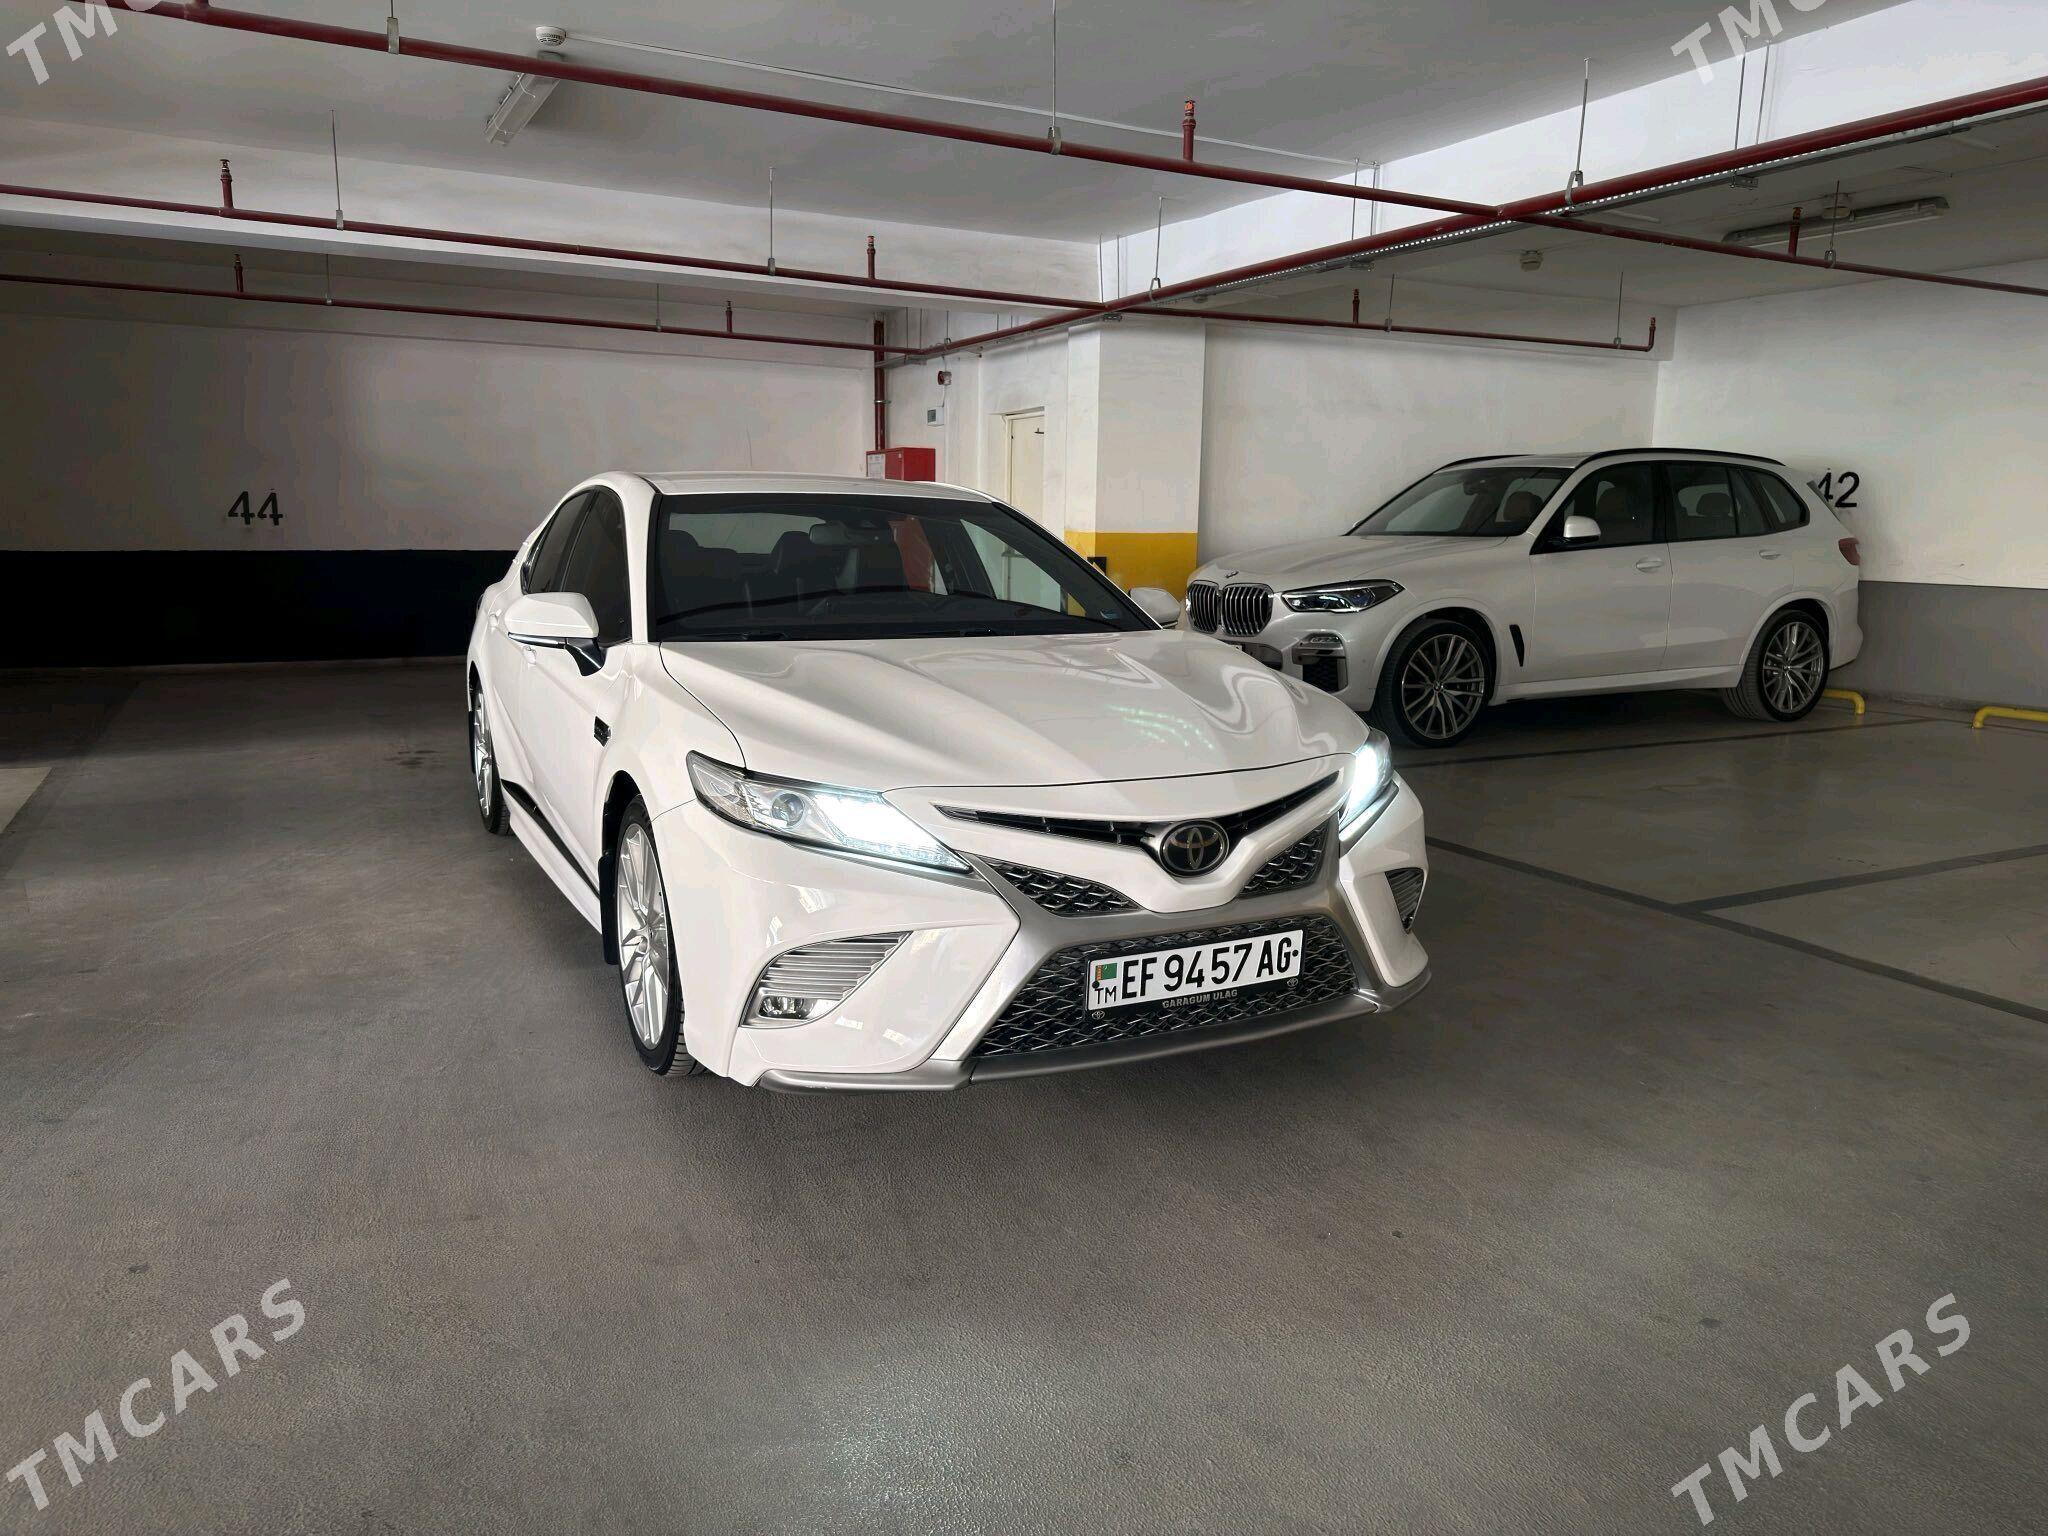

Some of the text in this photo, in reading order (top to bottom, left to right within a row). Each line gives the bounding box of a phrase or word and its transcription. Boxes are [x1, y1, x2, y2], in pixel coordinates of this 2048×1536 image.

[227, 491, 284, 526] 44
[1121, 936, 1292, 999] EF 9457 AG
[1094, 985, 1117, 1005] TM
[1162, 989, 1238, 1009] GARAGUM ULAG
